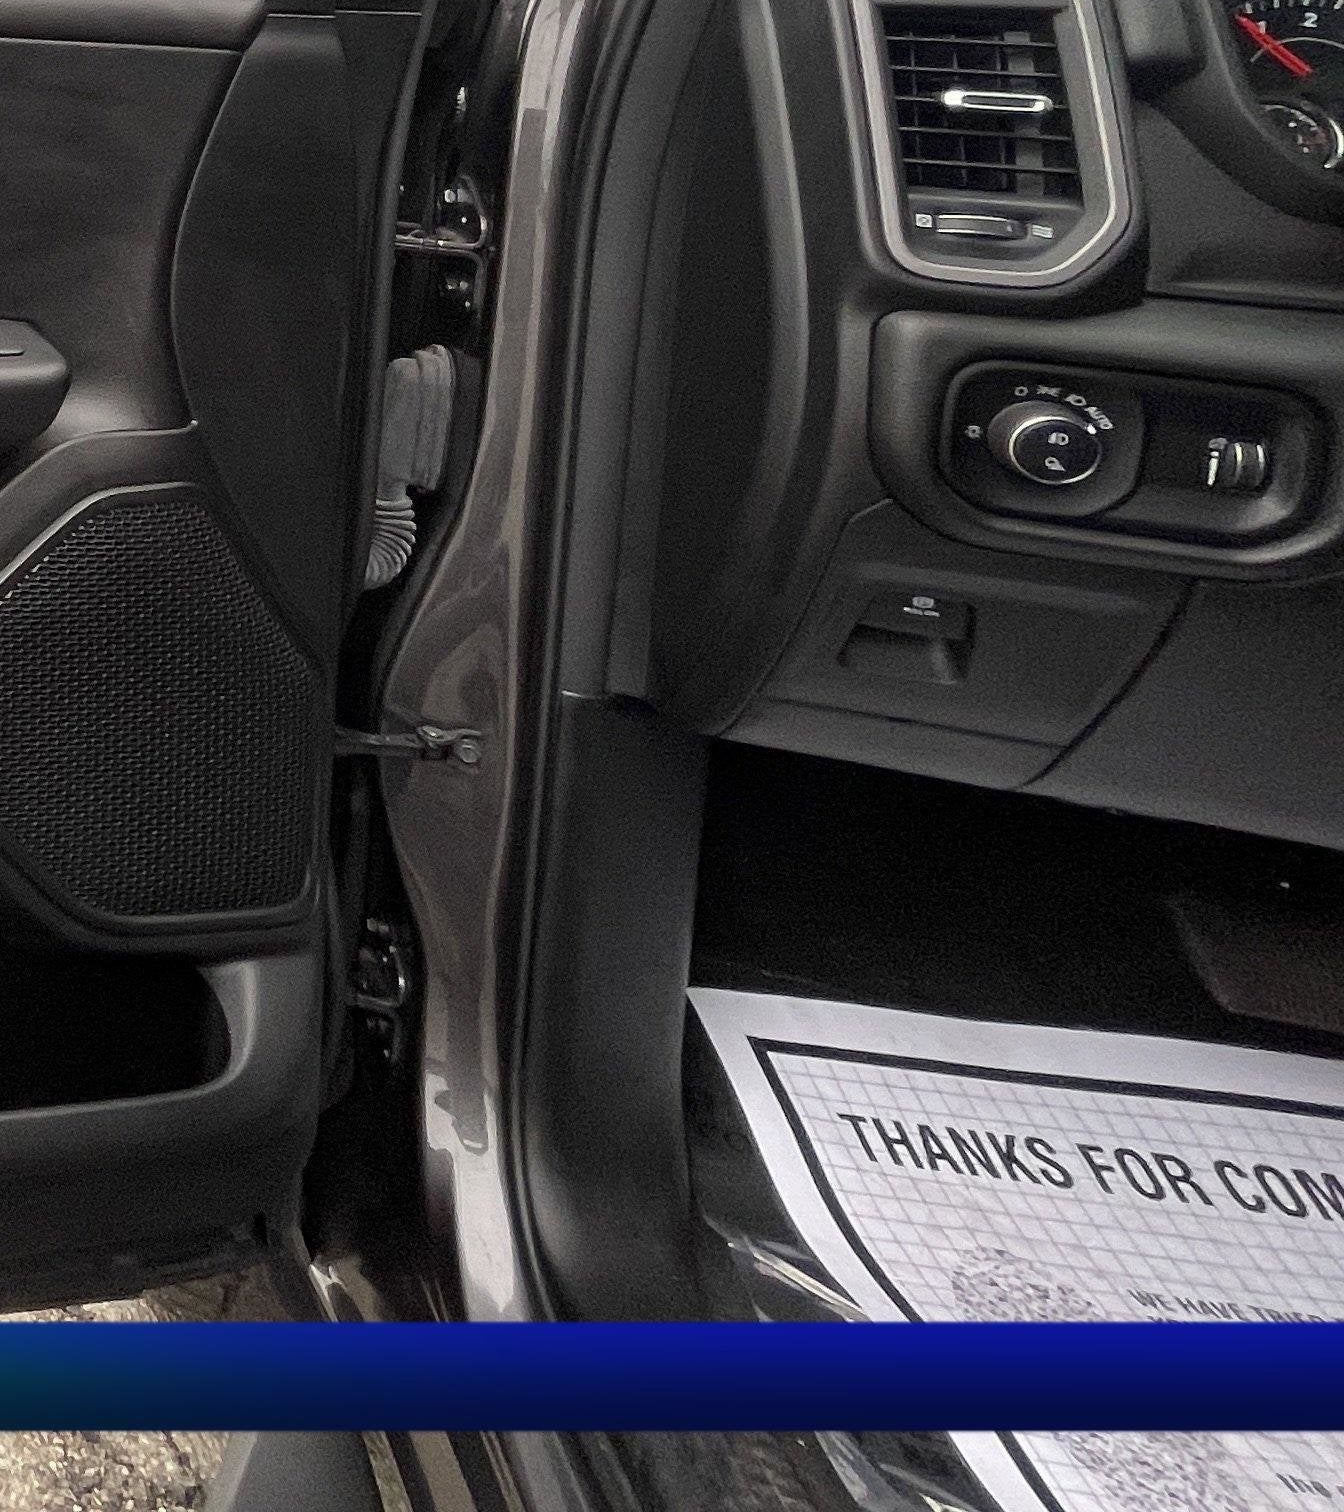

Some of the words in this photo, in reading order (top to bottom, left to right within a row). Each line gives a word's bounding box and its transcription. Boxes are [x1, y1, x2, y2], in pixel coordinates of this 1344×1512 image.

[836, 1112, 1074, 1190] THANKS
[1077, 1142, 1216, 1208] FOR
[1127, 1288, 1178, 1313] WE
[1173, 1295, 1251, 1322] HAVE
